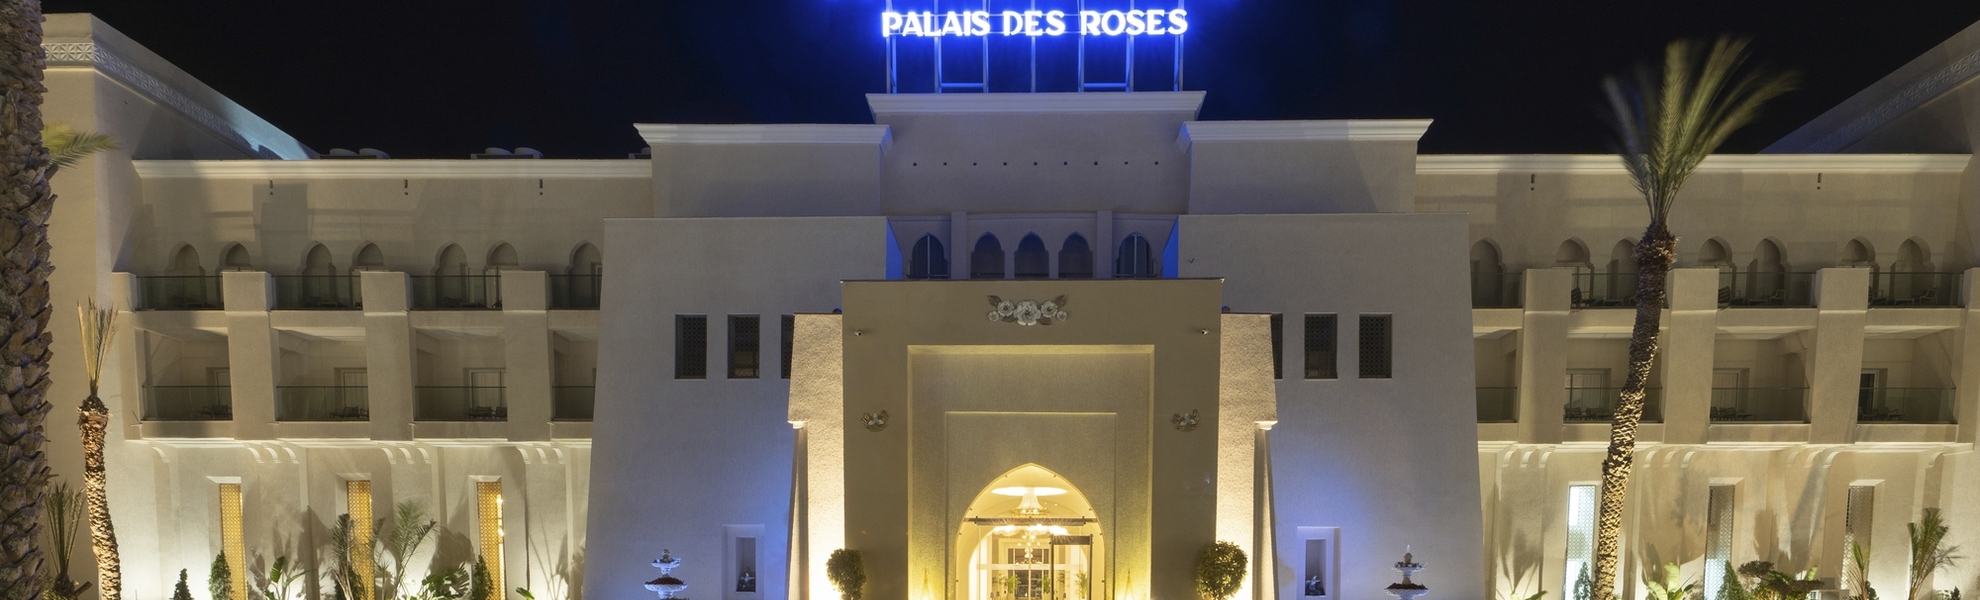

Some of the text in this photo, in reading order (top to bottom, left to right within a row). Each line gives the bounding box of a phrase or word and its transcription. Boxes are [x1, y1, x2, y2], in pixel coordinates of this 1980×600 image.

[882, 9, 1188, 37] PALAIS DES ROSES
